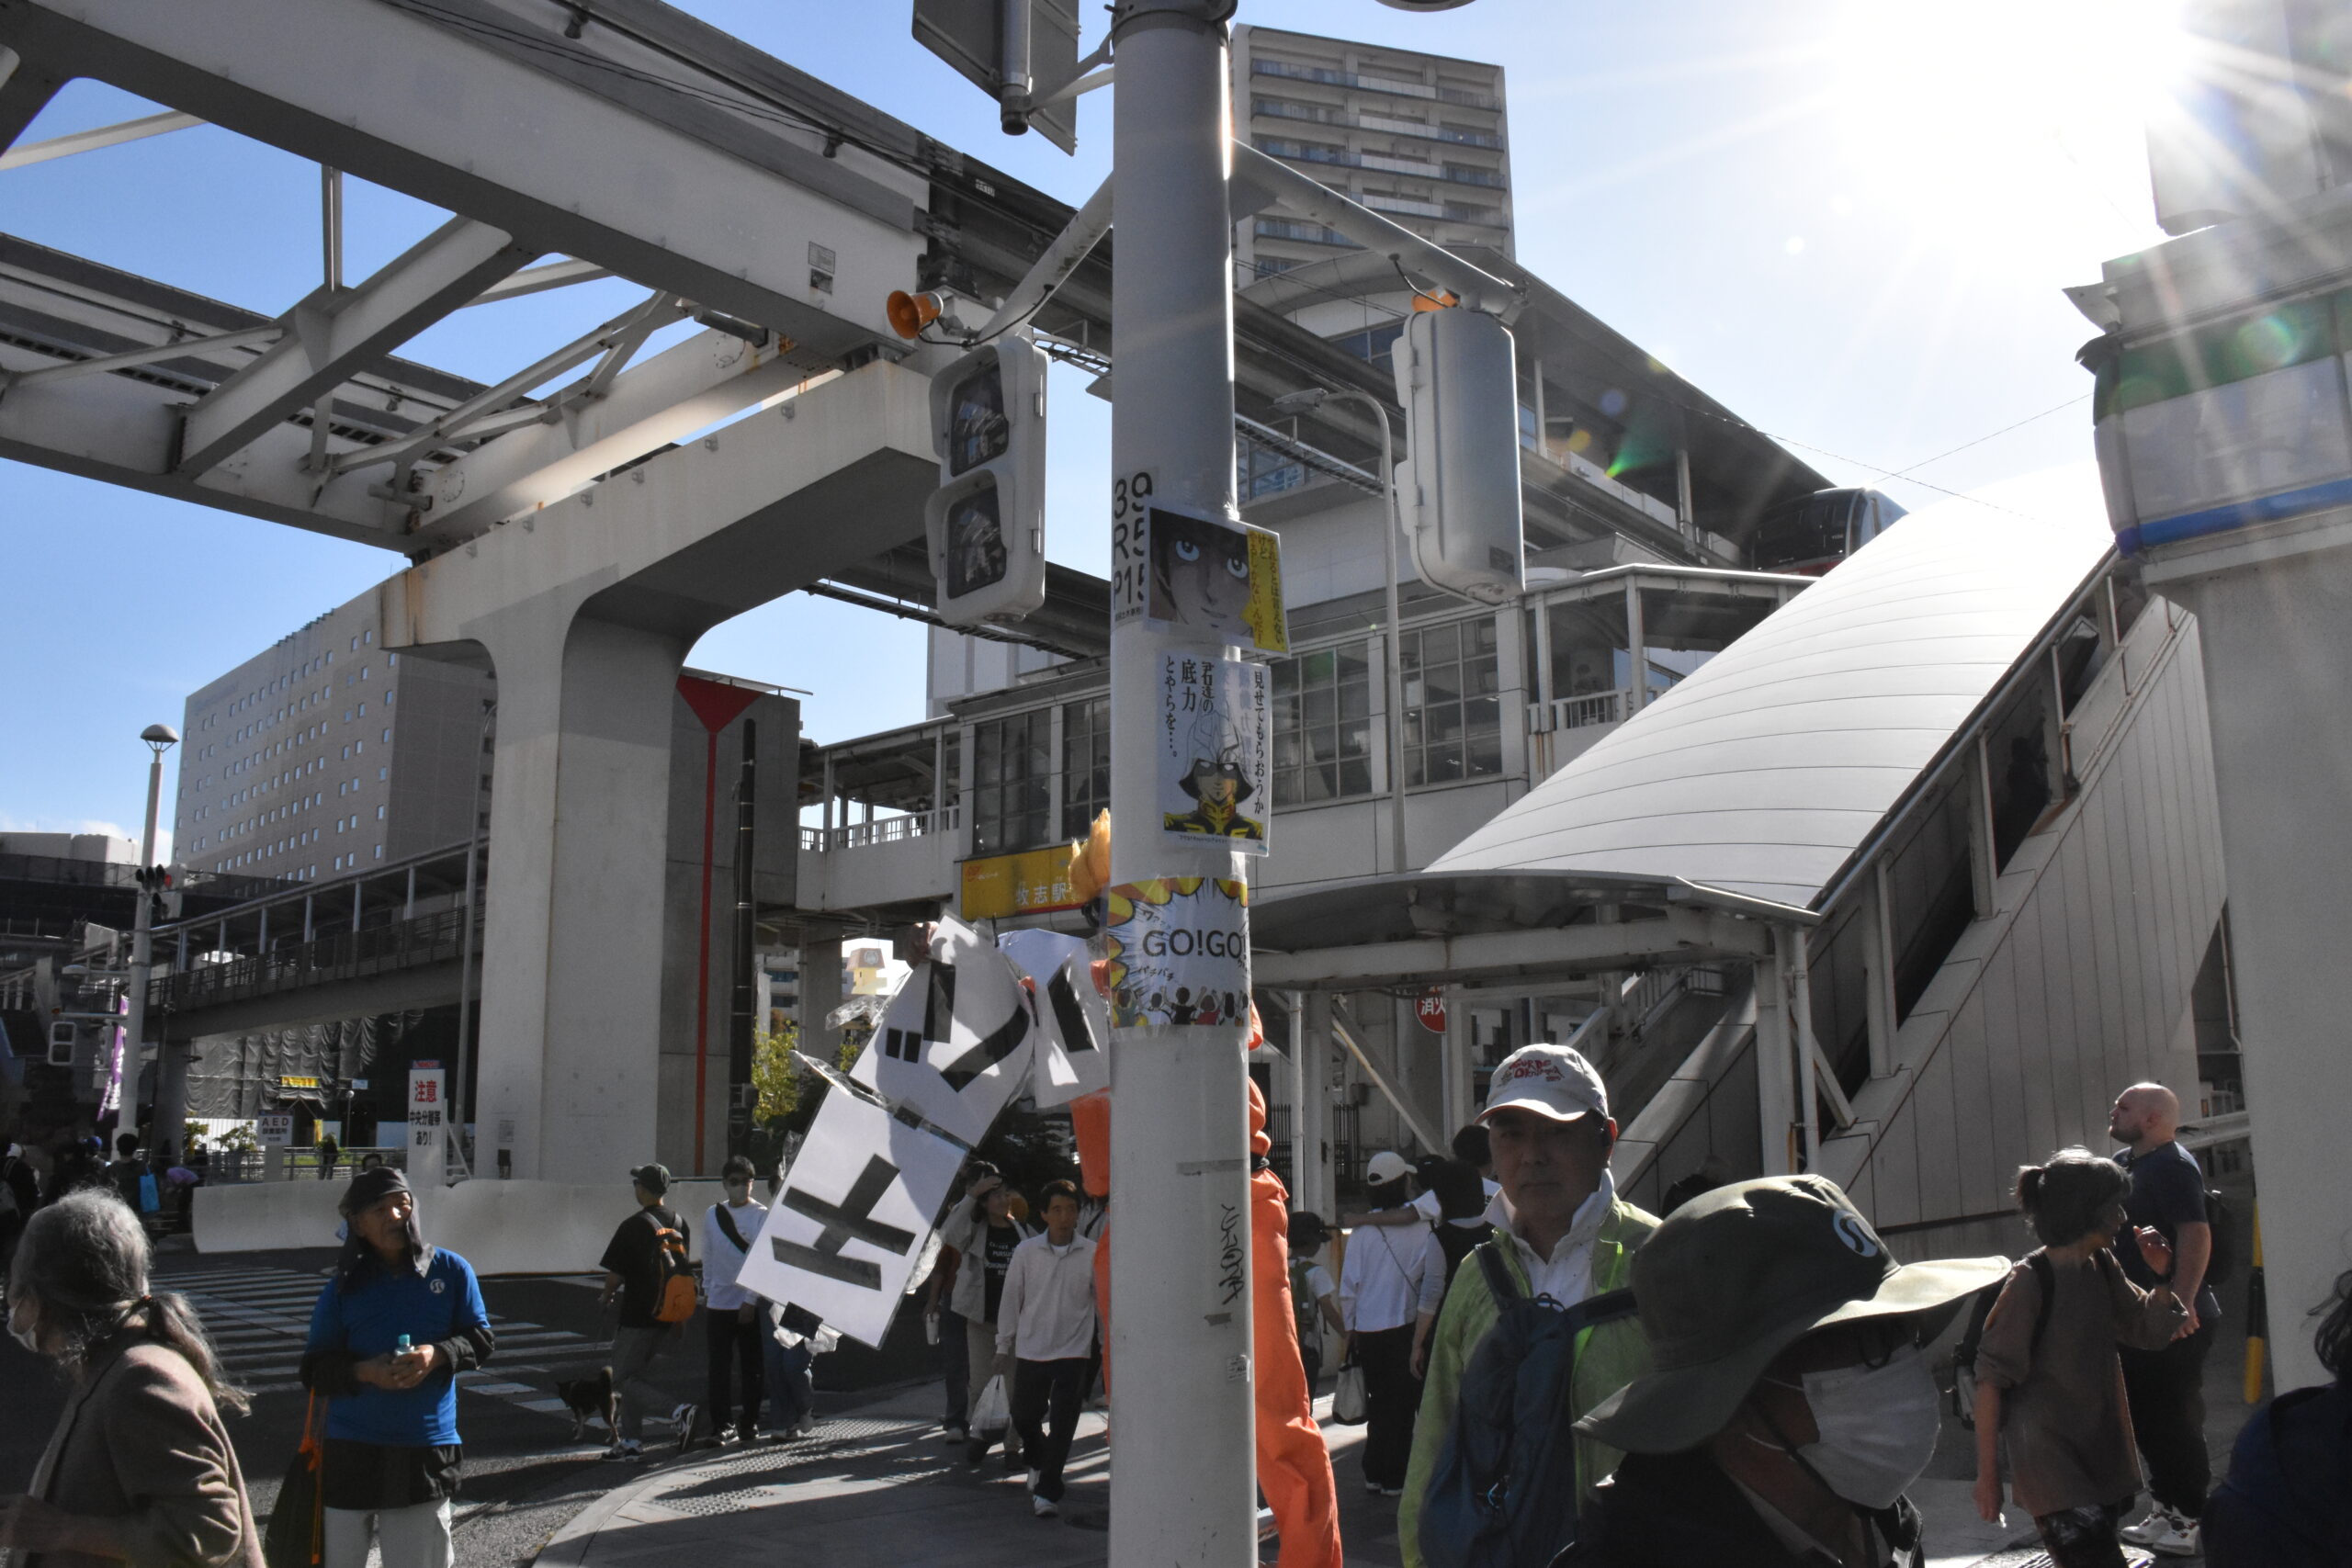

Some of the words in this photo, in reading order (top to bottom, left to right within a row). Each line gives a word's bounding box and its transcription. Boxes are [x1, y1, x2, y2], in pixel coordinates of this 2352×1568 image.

[1114, 471, 1153, 520] 39
[1181, 659, 1197, 713] 底力
[1201, 660, 1215, 714] 君達の
[1253, 671, 1265, 815] 見せてもらおうか
[414, 1079, 437, 1103] 注意
[261, 1116, 289, 1126] AED
